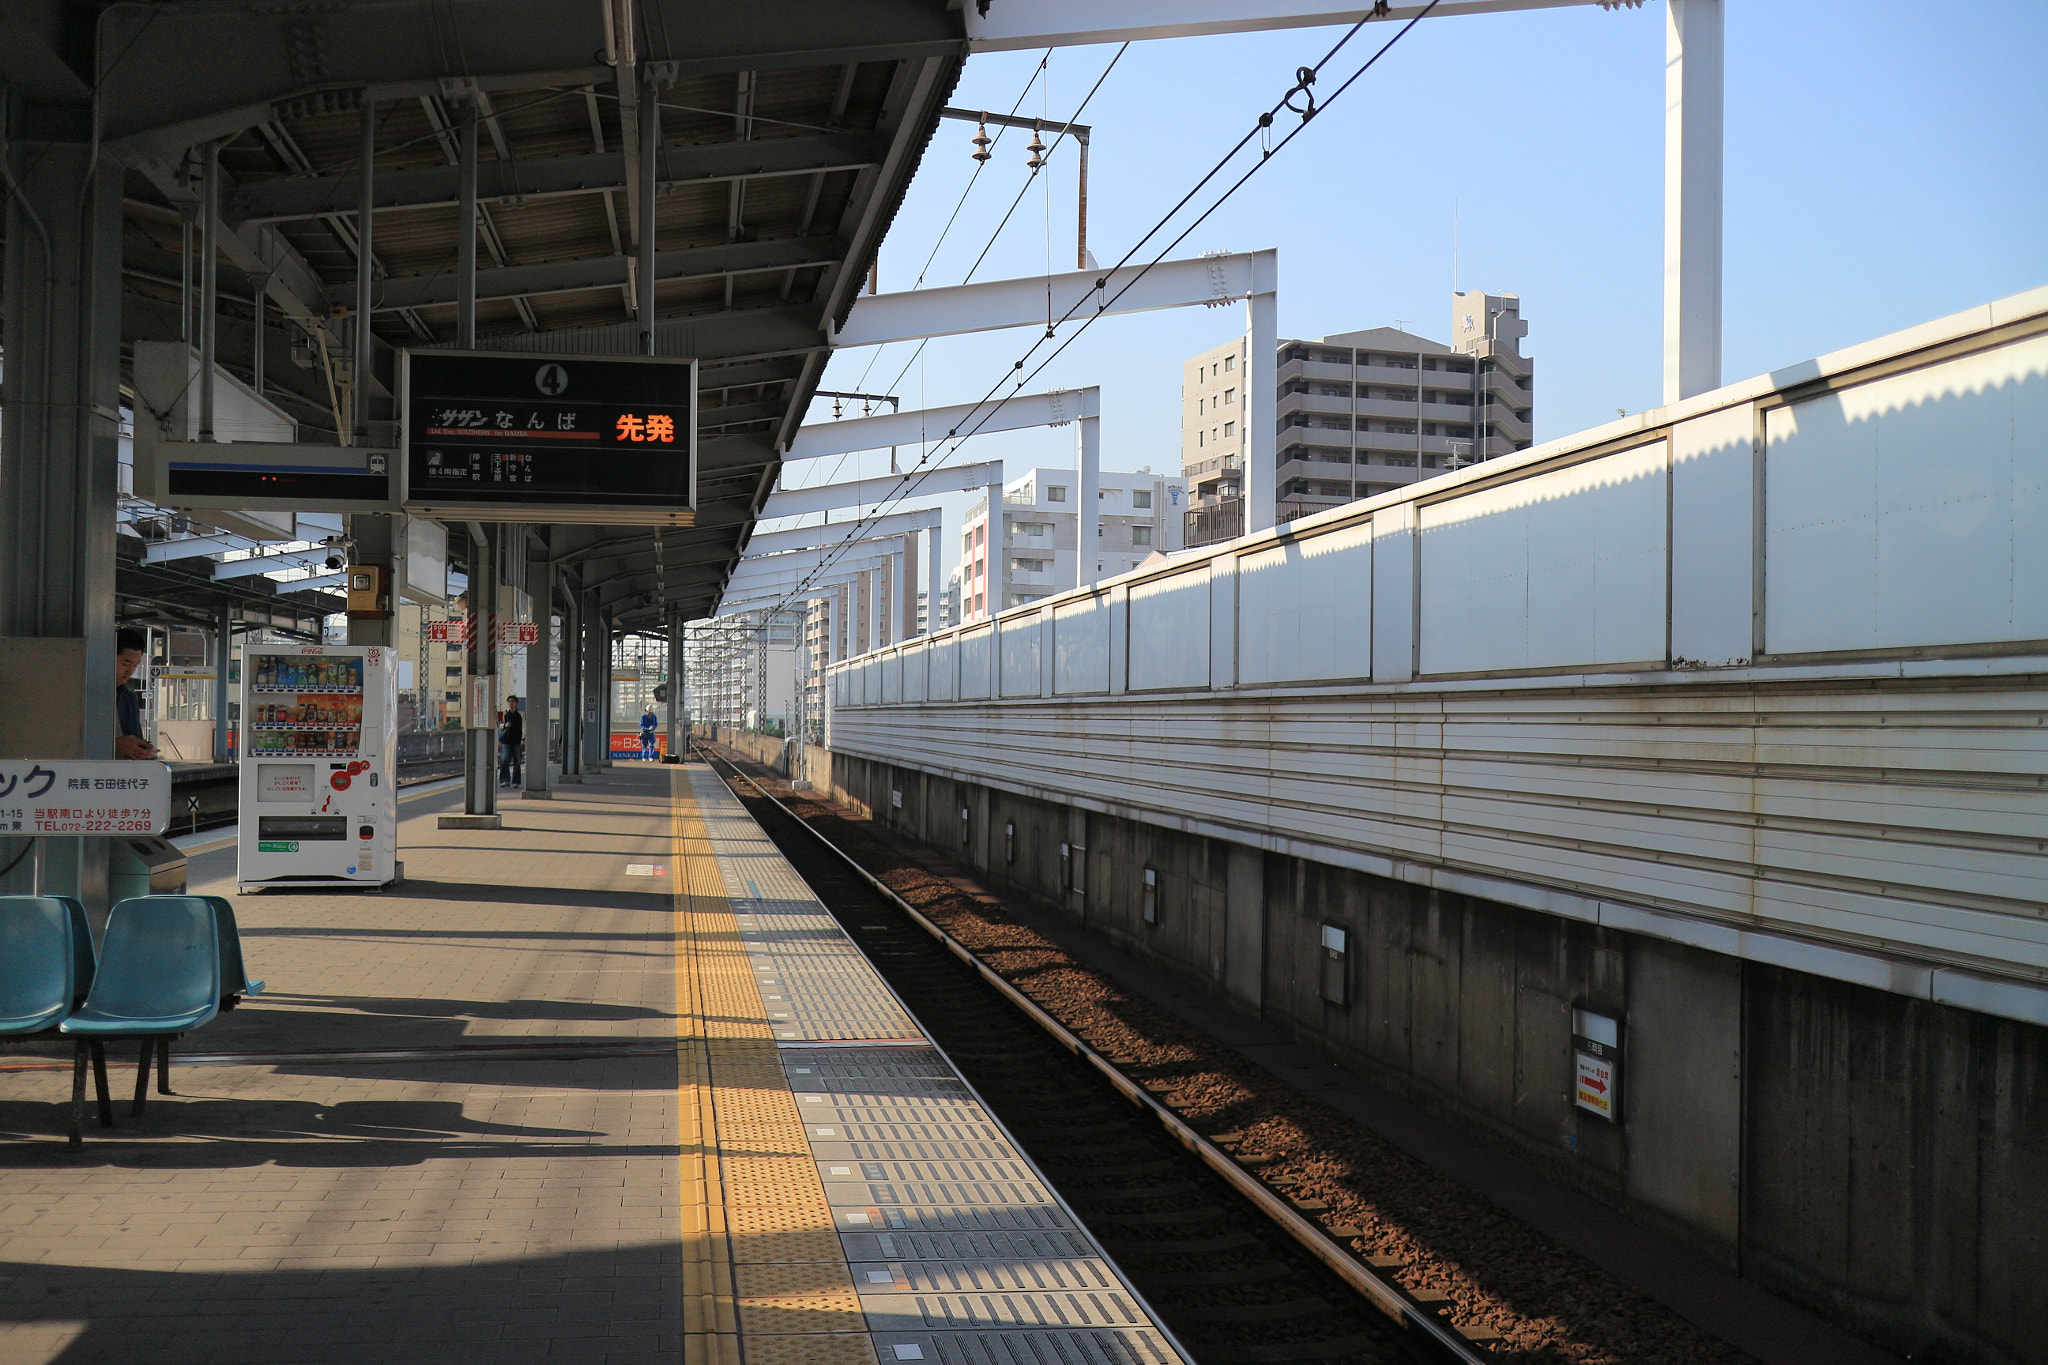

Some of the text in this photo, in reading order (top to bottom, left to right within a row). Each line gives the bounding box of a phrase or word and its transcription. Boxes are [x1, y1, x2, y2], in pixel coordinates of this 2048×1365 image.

[542, 365, 560, 394] 4
[495, 410, 576, 430] なんば
[615, 413, 675, 443] 先発
[524, 454, 533, 482] なんば
[68, 778, 90, 790] 院長
[94, 778, 149, 790] 石田佳代子
[34, 808, 152, 819] 当駅南口より徒歩7分
[12, 821, 22, 831] 東
[35, 820, 152, 832] TEL072-222-2269
